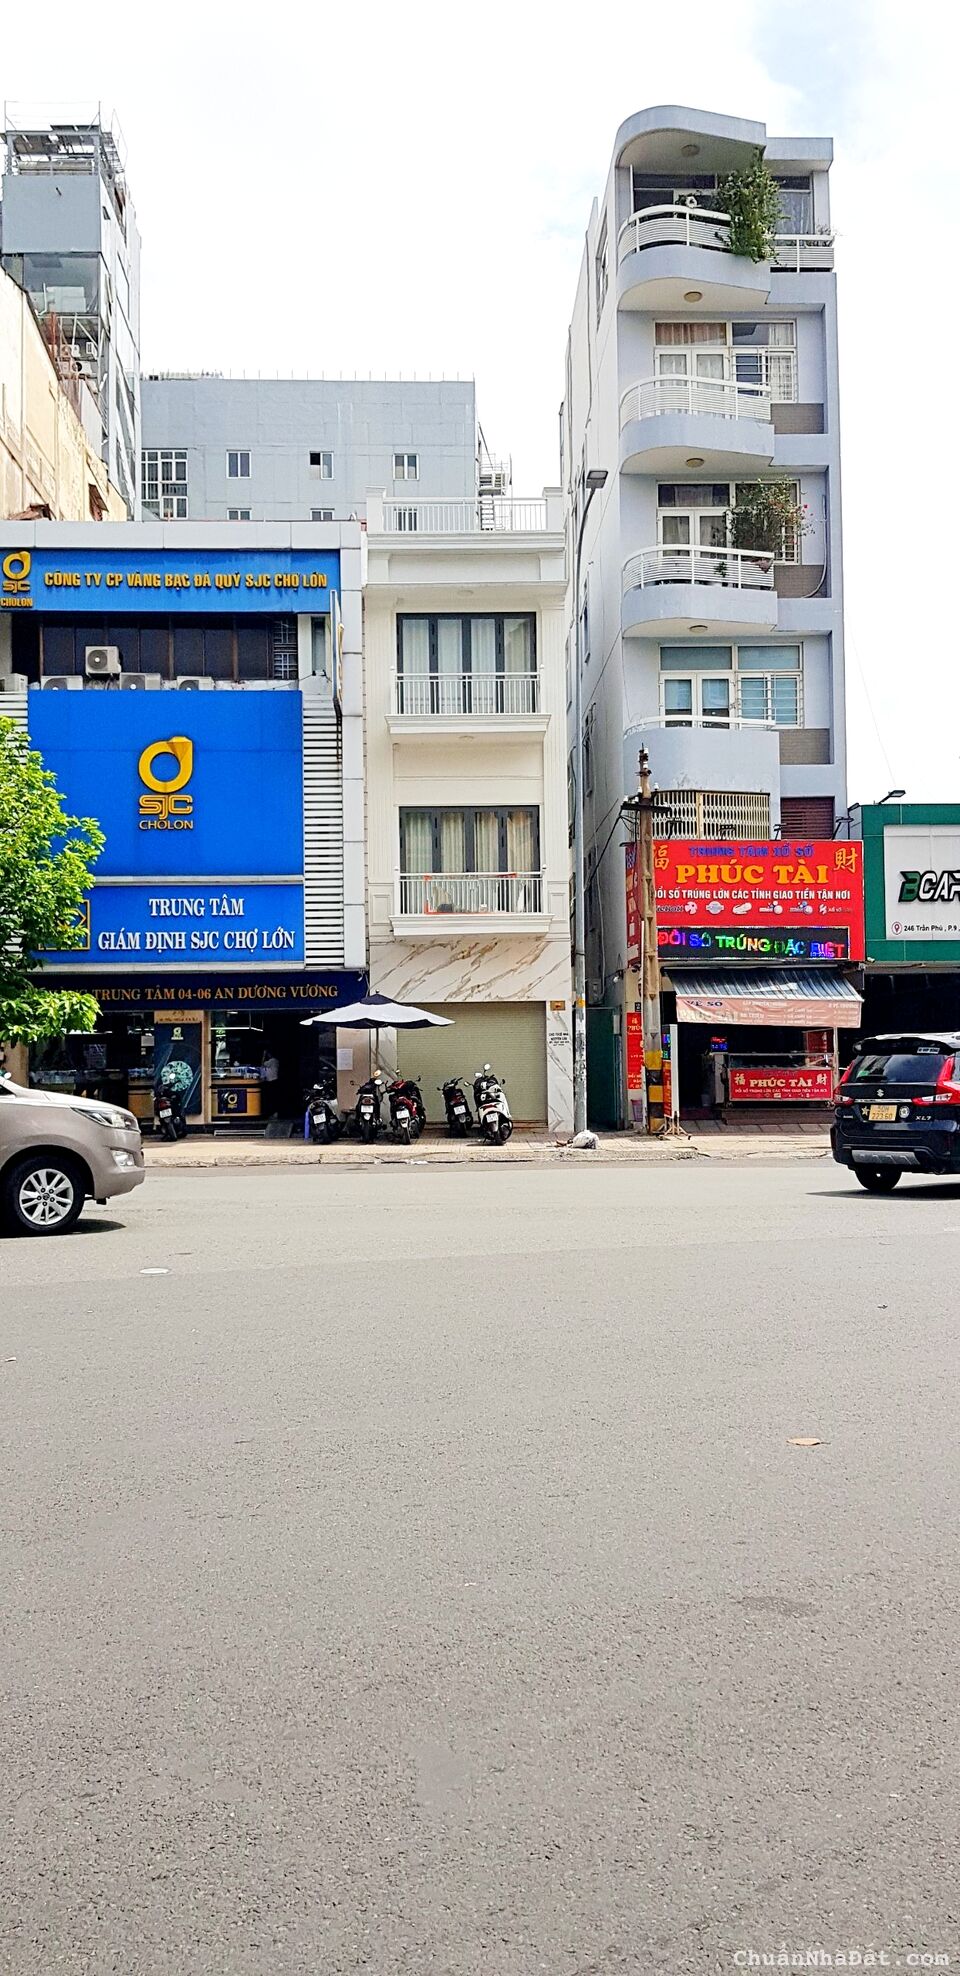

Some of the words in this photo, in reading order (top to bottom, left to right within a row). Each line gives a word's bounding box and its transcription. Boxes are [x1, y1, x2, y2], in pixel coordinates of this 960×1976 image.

[44, 570, 81, 587] CÔNG
[85, 572, 101, 587] TY
[106, 572, 123, 587] CP
[127, 571, 161, 588] VÀNG
[165, 573, 190, 590] BẠC
[194, 571, 211, 588] ĐÁ
[245, 573, 270, 588] SJC
[274, 573, 300, 592] CHỢ
[302, 571, 327, 588] LỚN
[139, 794, 193, 820] SJC
[139, 820, 194, 830] CHOLON
[675, 858, 764, 885] PHÚC
[772, 858, 829, 885] TÀI
[833, 847, 858, 874] 財
[655, 885, 667, 899] ỔI
[668, 886, 681, 899] SỐ
[682, 887, 711, 899] TRÚNG
[731, 887, 749, 899] CÁC
[751, 887, 771, 899] TỈNH
[773, 890, 793, 900] GIAO
[835, 889, 851, 900] NƠI
[149, 898, 205, 917] TRUNG
[210, 893, 244, 917] TÂM
[98, 928, 140, 950] GIÁM
[145, 931, 186, 953] ĐỊNH
[190, 931, 219, 950] SJC
[224, 928, 258, 952] CHỢ
[262, 926, 295, 949] LỚN
[715, 933, 771, 953] TRÚNG
[93, 988, 141, 1000] TRUNG
[145, 985, 174, 1000] TÂM
[178, 988, 211, 1000] 04-06
[214, 987, 234, 999] AN
[238, 984, 286, 999] DƯƠNG
[290, 983, 338, 998] VƯƠNG
[750, 1077, 786, 1088] PHÚC
[788, 1077, 813, 1088] TÀI
